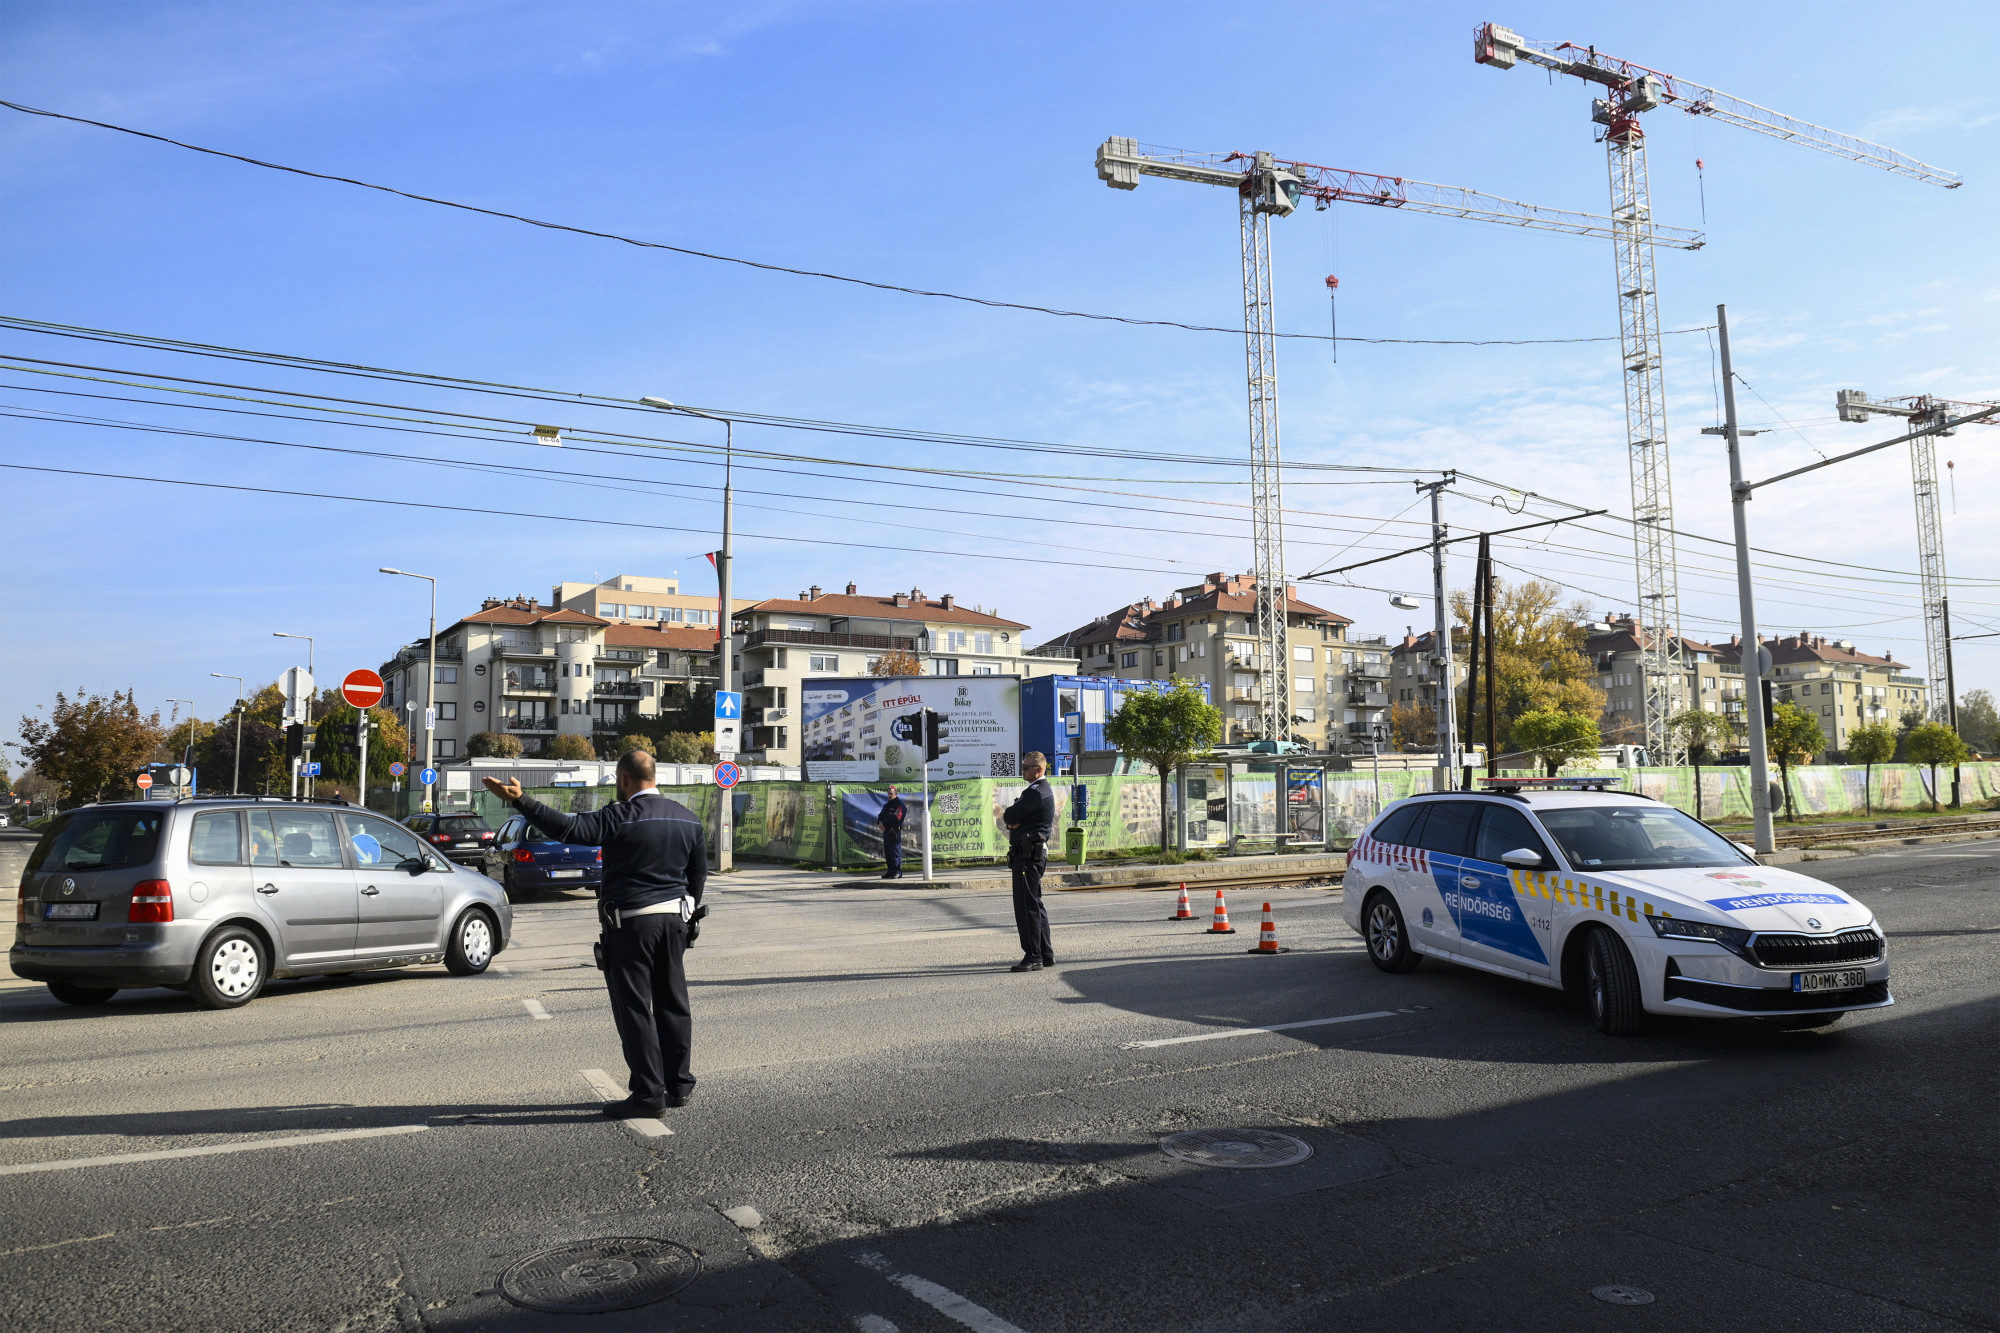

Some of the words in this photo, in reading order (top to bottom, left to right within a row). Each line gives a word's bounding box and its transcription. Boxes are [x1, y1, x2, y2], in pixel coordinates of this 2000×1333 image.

[883, 699, 896, 708] ITT
[898, 695, 921, 706] ÉPÜL!
[931, 819, 943, 828] AZ
[945, 817, 982, 827] OTTHON
[933, 830, 968, 840] AHOVÁ
[969, 828, 980, 839] JÓ
[1445, 892, 1511, 922] RENDŐRSÉG
[1729, 893, 1835, 908] RENDŐRSÉG
[1537, 918, 1550, 930] 112
[1823, 971, 1863, 988] MK-380
